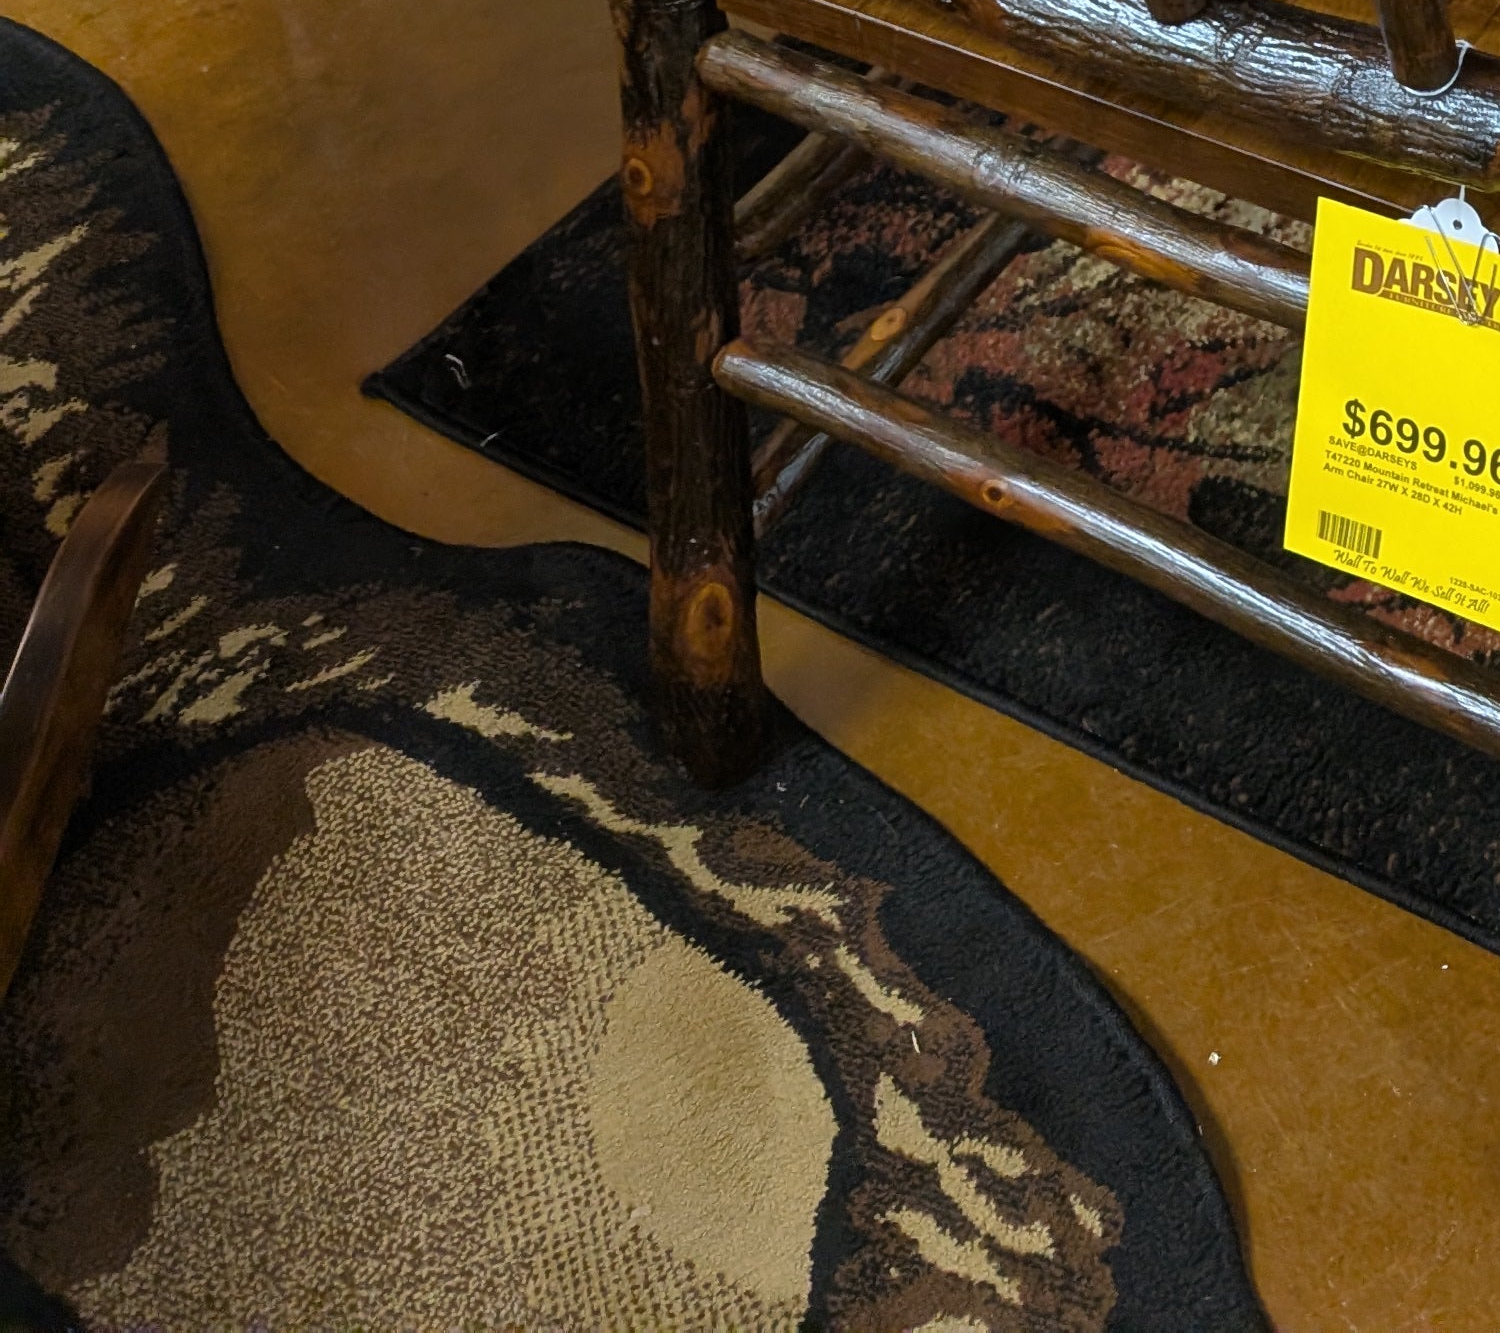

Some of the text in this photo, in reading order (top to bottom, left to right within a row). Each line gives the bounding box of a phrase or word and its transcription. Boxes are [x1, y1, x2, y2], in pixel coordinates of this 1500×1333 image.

[1328, 435, 1418, 471] SAVE@DARSEYS
[1323, 462, 1463, 515] Arm Chair 27W X 28D X 42H
[1325, 449, 1499, 515] T47220 Mountain Retreat Michael's
[1333, 549, 1364, 569] Wall
[1363, 560, 1378, 575] To
[1380, 565, 1412, 585] Wall
[1410, 576, 1430, 593] We
[1431, 585, 1456, 602] Sell
[1453, 592, 1468, 607] It
